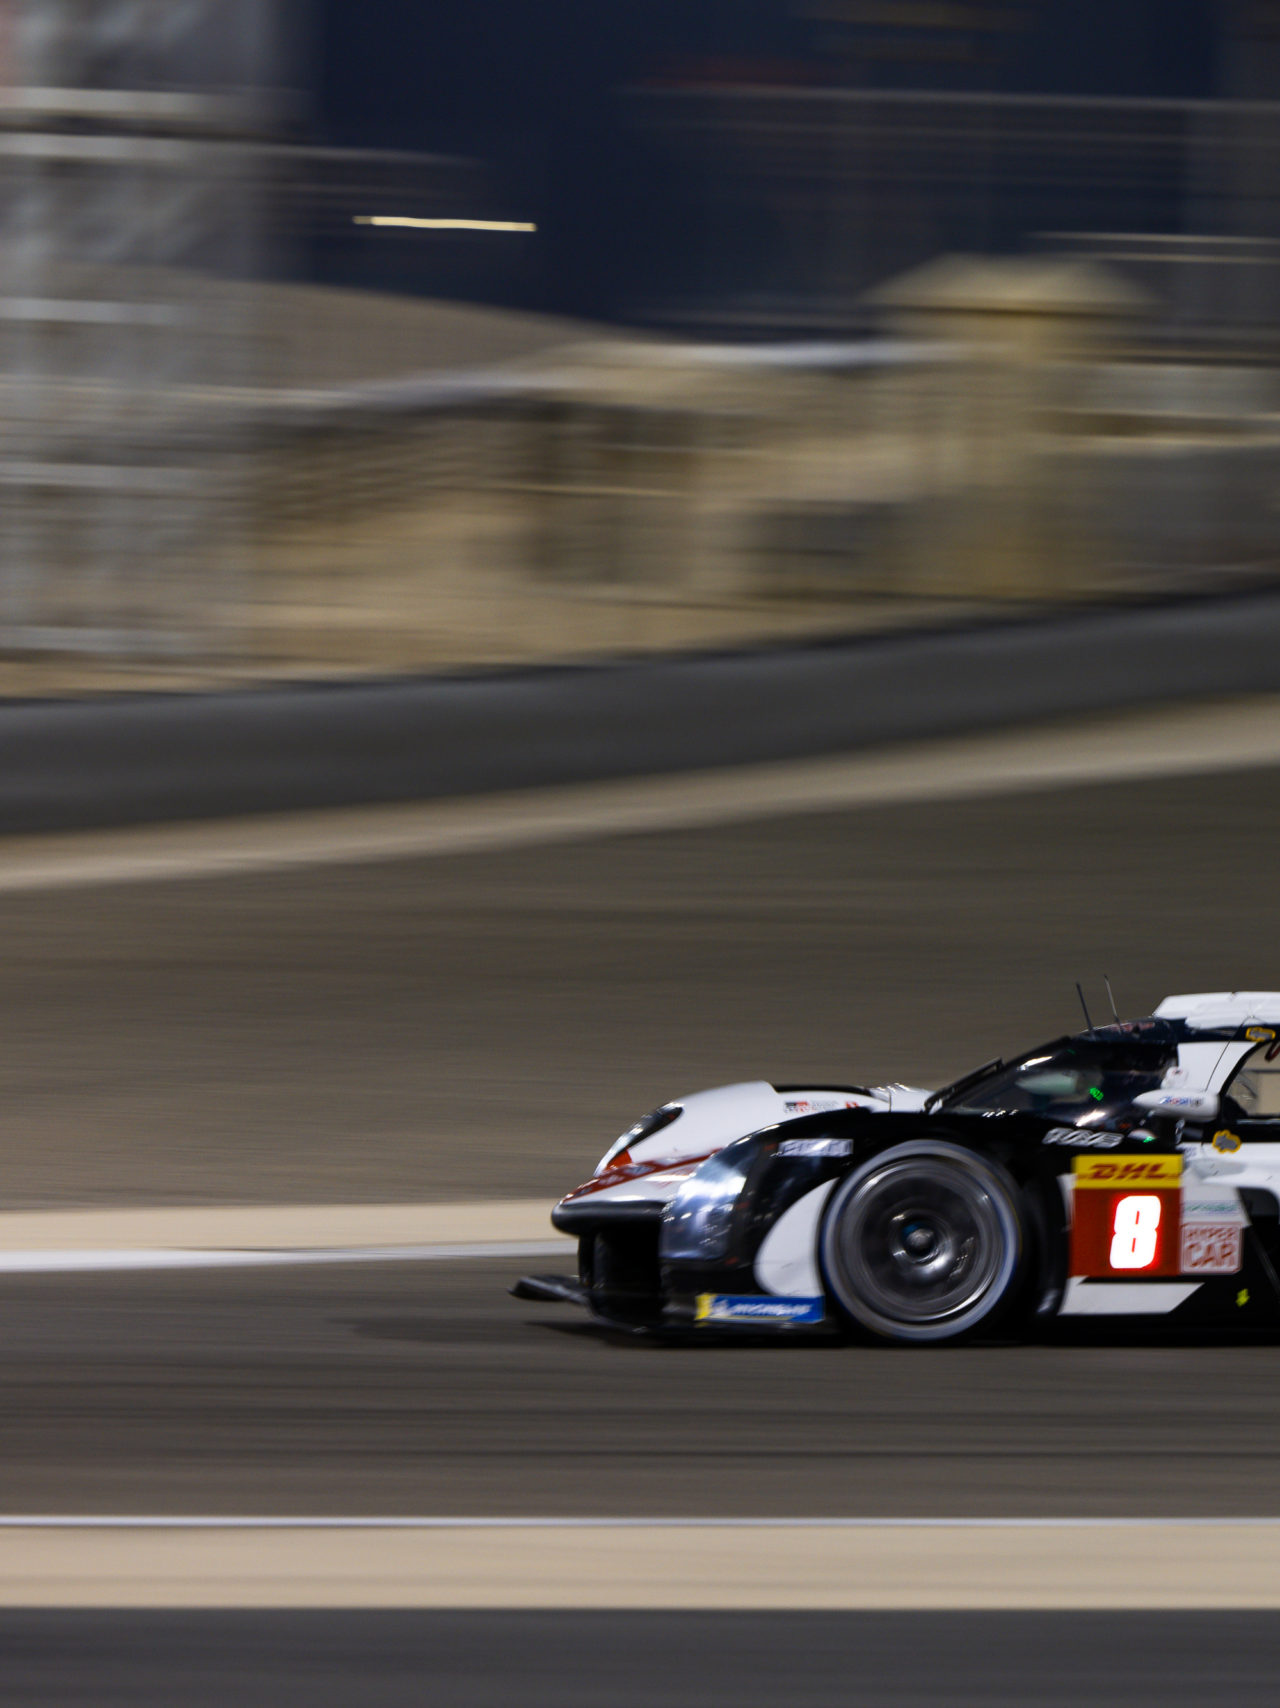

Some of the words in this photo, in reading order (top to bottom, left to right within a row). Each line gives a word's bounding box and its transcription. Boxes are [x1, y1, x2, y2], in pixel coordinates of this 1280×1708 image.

[1089, 1163, 1167, 1180] DHL
[1109, 1195, 1162, 1269] 8
[1185, 1242, 1236, 1268] CAR
